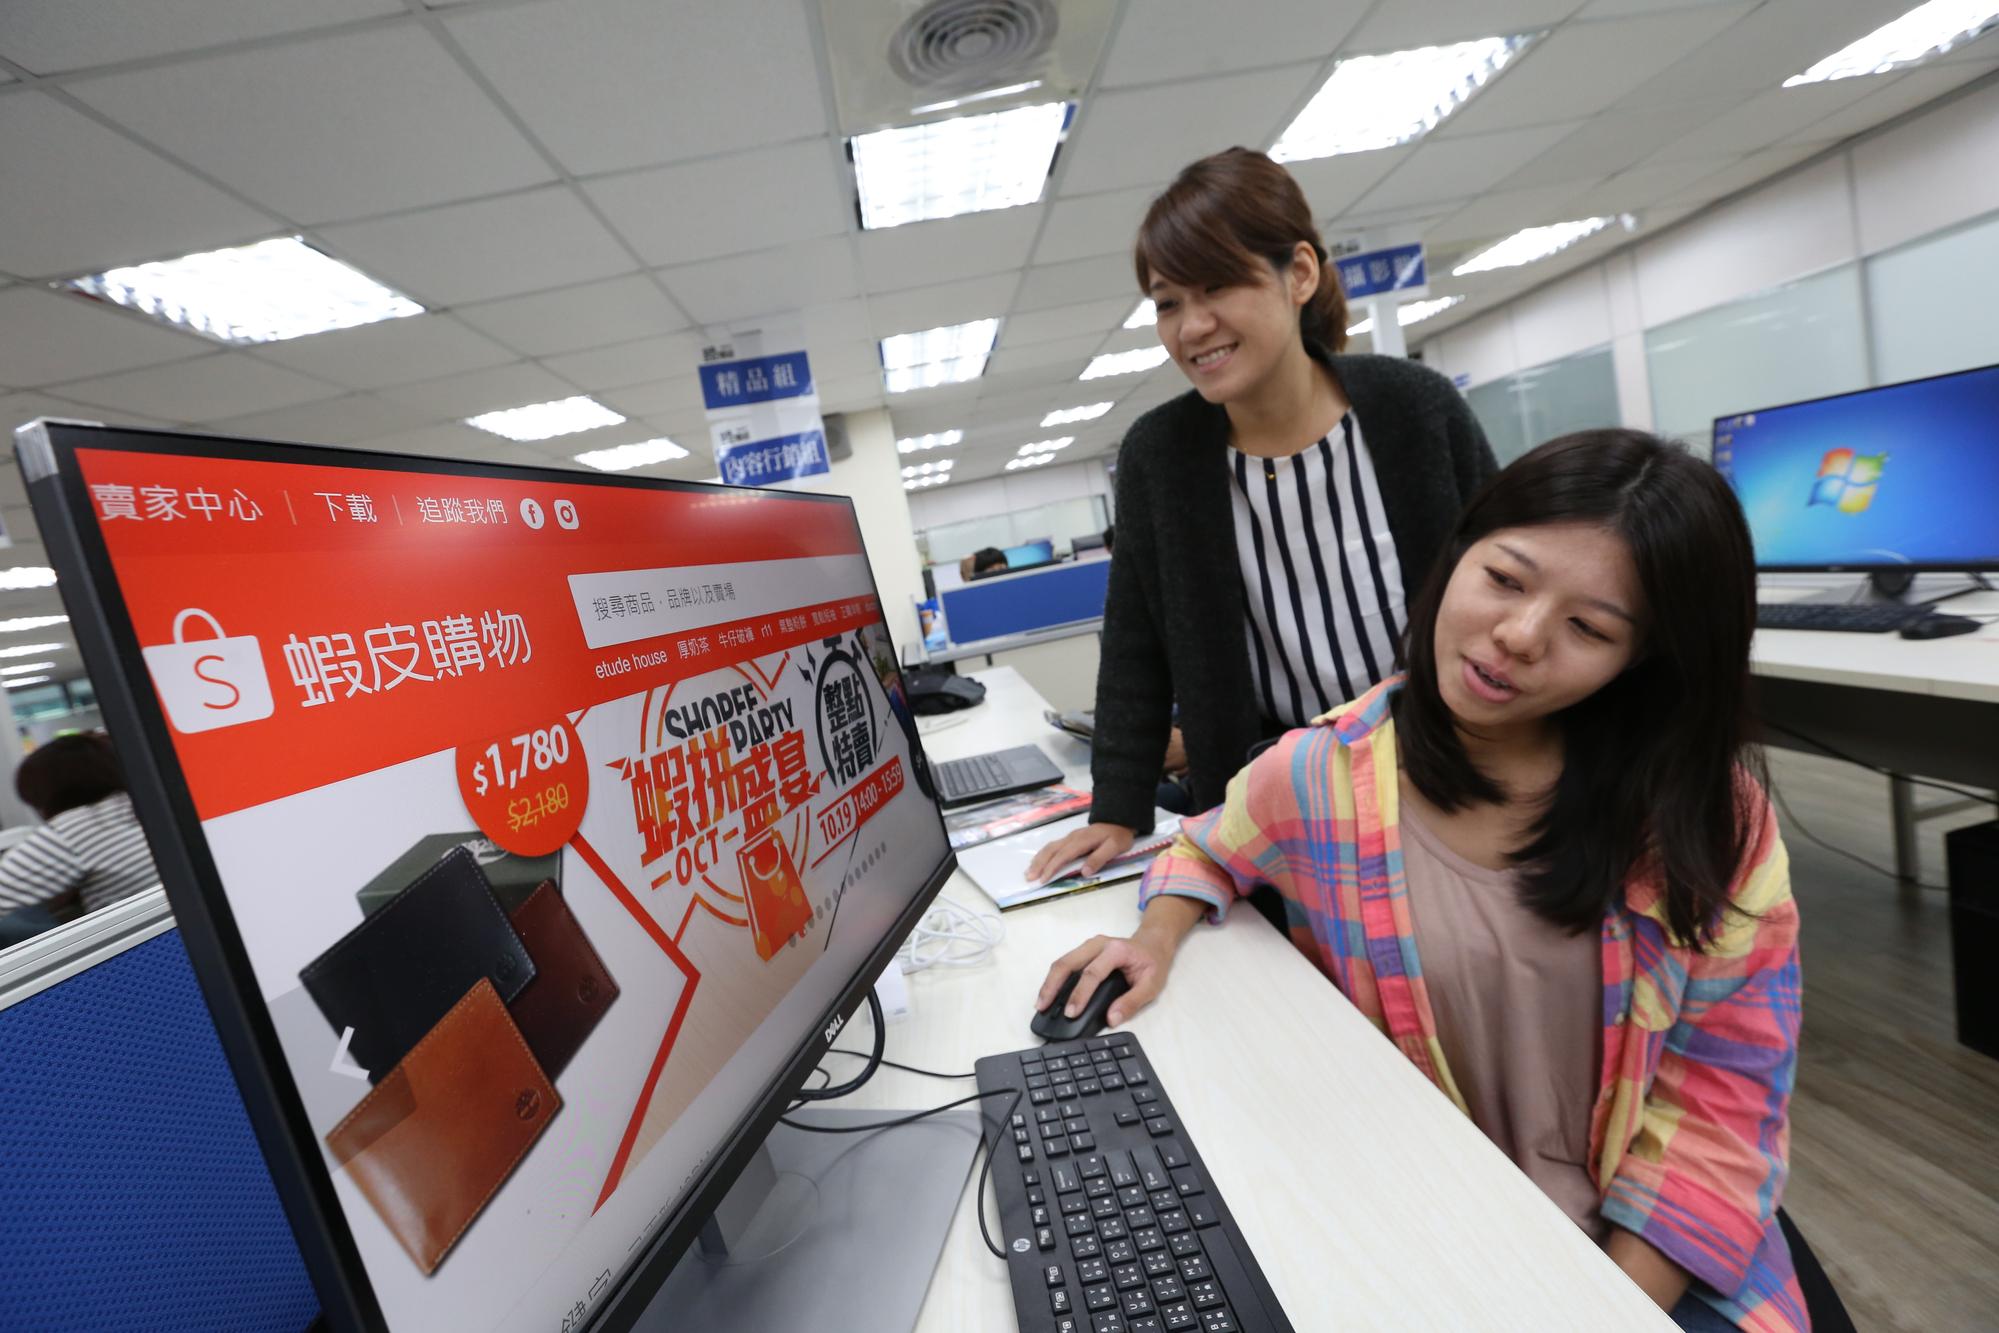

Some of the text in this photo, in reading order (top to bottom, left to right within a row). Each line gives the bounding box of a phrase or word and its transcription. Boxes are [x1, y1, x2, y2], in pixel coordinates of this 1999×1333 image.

[716, 363, 797, 397] 精品組
[725, 440, 822, 481] 內容行銷組
[90, 484, 263, 522] 賣家中心
[313, 492, 377, 522] 下載
[416, 496, 508, 524] 追蹤我們
[283, 610, 532, 708] 蝦皮購物
[595, 650, 667, 679] etude house
[677, 637, 711, 659] 厚奶茶
[193, 654, 240, 710] S
[823, 673, 865, 734] 整點
[729, 697, 794, 753] PARTY
[472, 723, 570, 797] $1,780
[832, 721, 875, 786] 特賣
[508, 783, 569, 833] $2,180
[630, 725, 811, 868] 蝦拼盛宴
[819, 803, 852, 845] 10.19
[854, 784, 878, 817] 14:00
[881, 764, 902, 793] 15:59
[676, 828, 718, 886] OCT
[824, 1013, 844, 1043] DELL
